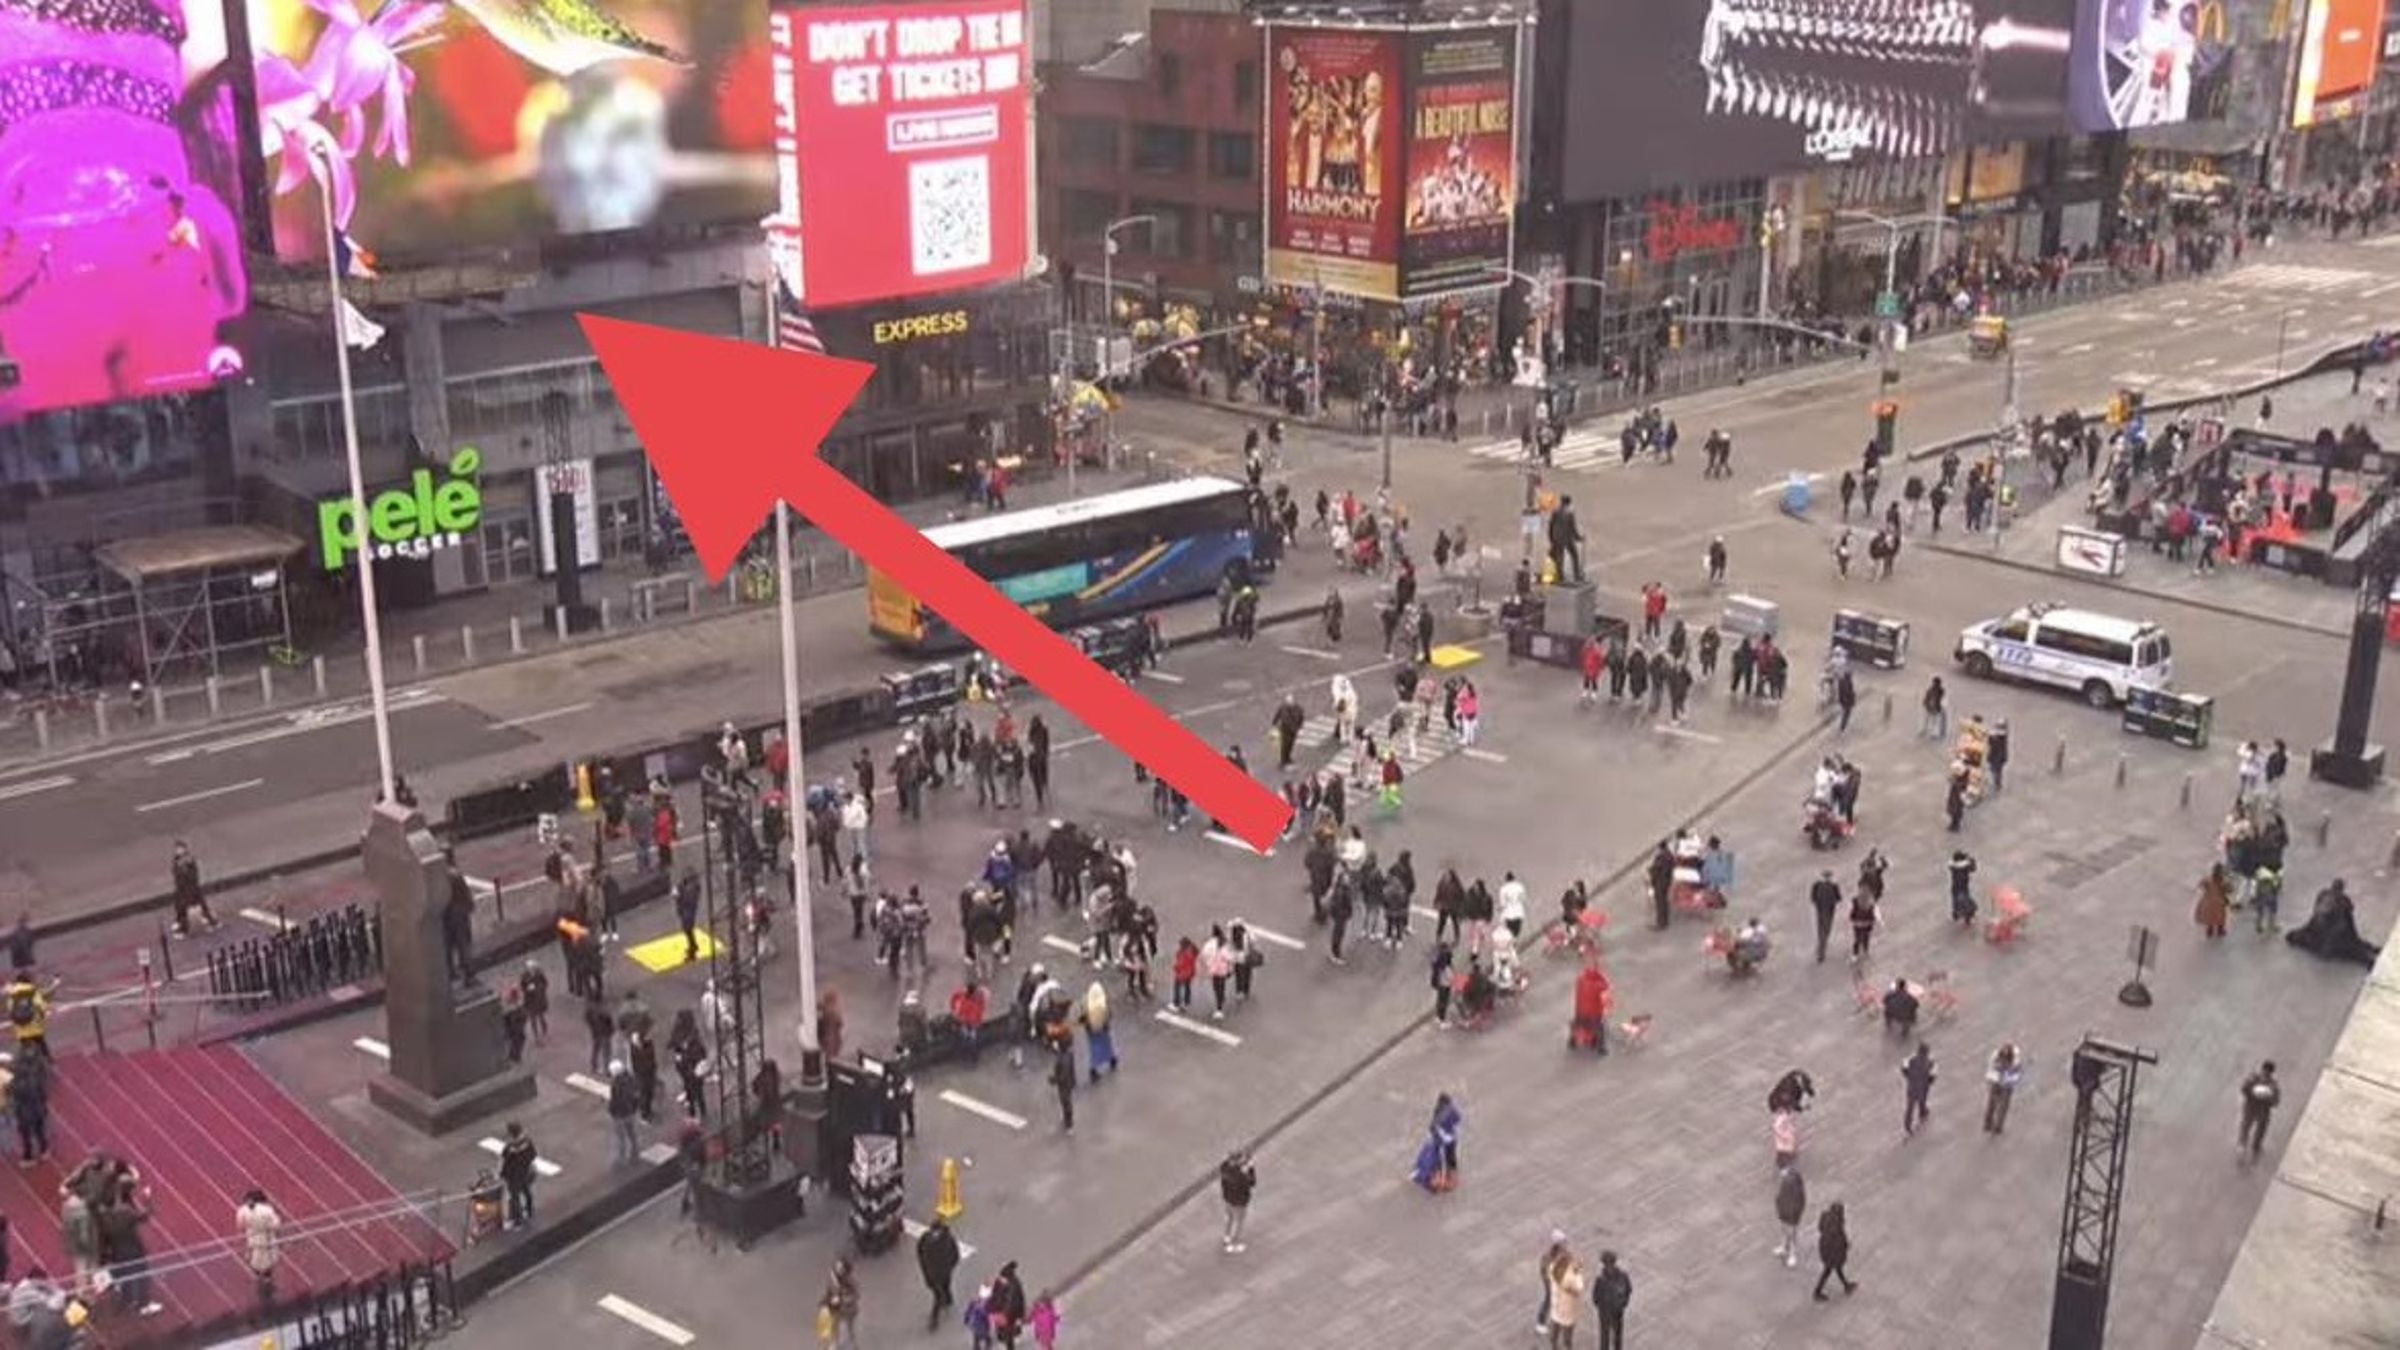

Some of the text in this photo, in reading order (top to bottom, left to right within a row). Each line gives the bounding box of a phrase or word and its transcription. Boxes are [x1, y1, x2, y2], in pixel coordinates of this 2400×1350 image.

[808, 20, 890, 62] DON'T
[897, 16, 962, 56] DROP
[833, 65, 882, 106] GET
[887, 58, 981, 101] TICKETS
[1425, 102, 1477, 139] BEAUTIFUL
[1287, 188, 1382, 222] HARMONY
[874, 310, 967, 343] EXPRESS
[319, 448, 480, 570] pelé
[367, 531, 460, 560] OCCER
